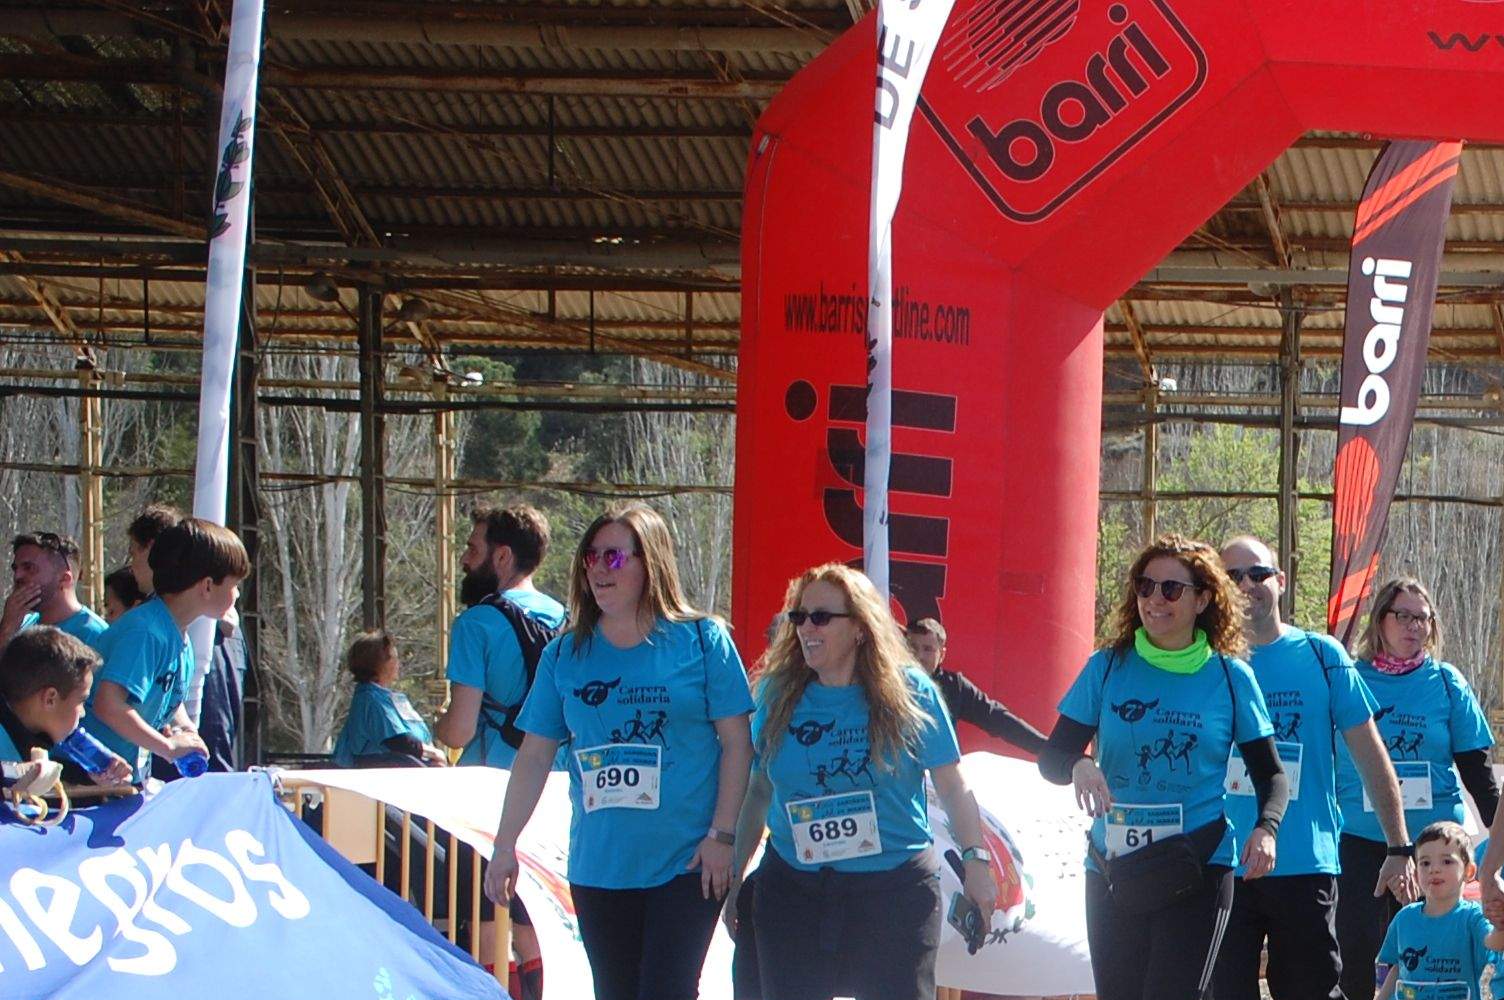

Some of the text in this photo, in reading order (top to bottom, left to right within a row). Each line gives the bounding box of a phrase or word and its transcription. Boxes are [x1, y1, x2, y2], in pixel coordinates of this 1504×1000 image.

[874, 23, 915, 131] DE
[964, 3, 1172, 184] barri
[1340, 256, 1412, 427] barri
[596, 767, 640, 790] 690
[809, 817, 858, 842] 689
